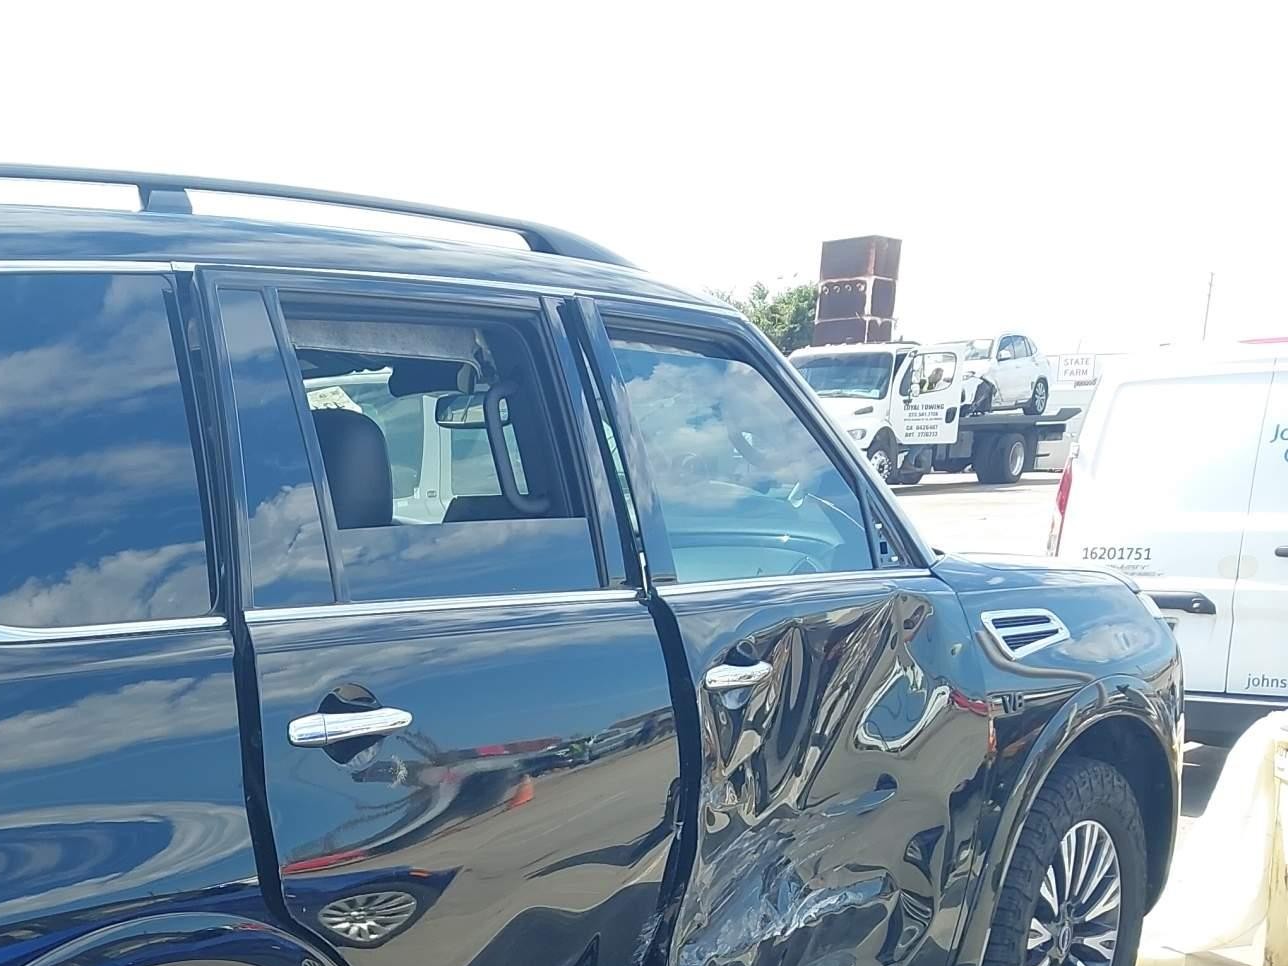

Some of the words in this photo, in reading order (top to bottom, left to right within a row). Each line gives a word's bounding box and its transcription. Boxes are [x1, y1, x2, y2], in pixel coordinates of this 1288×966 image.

[1063, 357, 1090, 367] STATE
[1063, 368, 1088, 377] FARM
[1082, 546, 1152, 561] 16201751
[1244, 673, 1288, 690] johns
